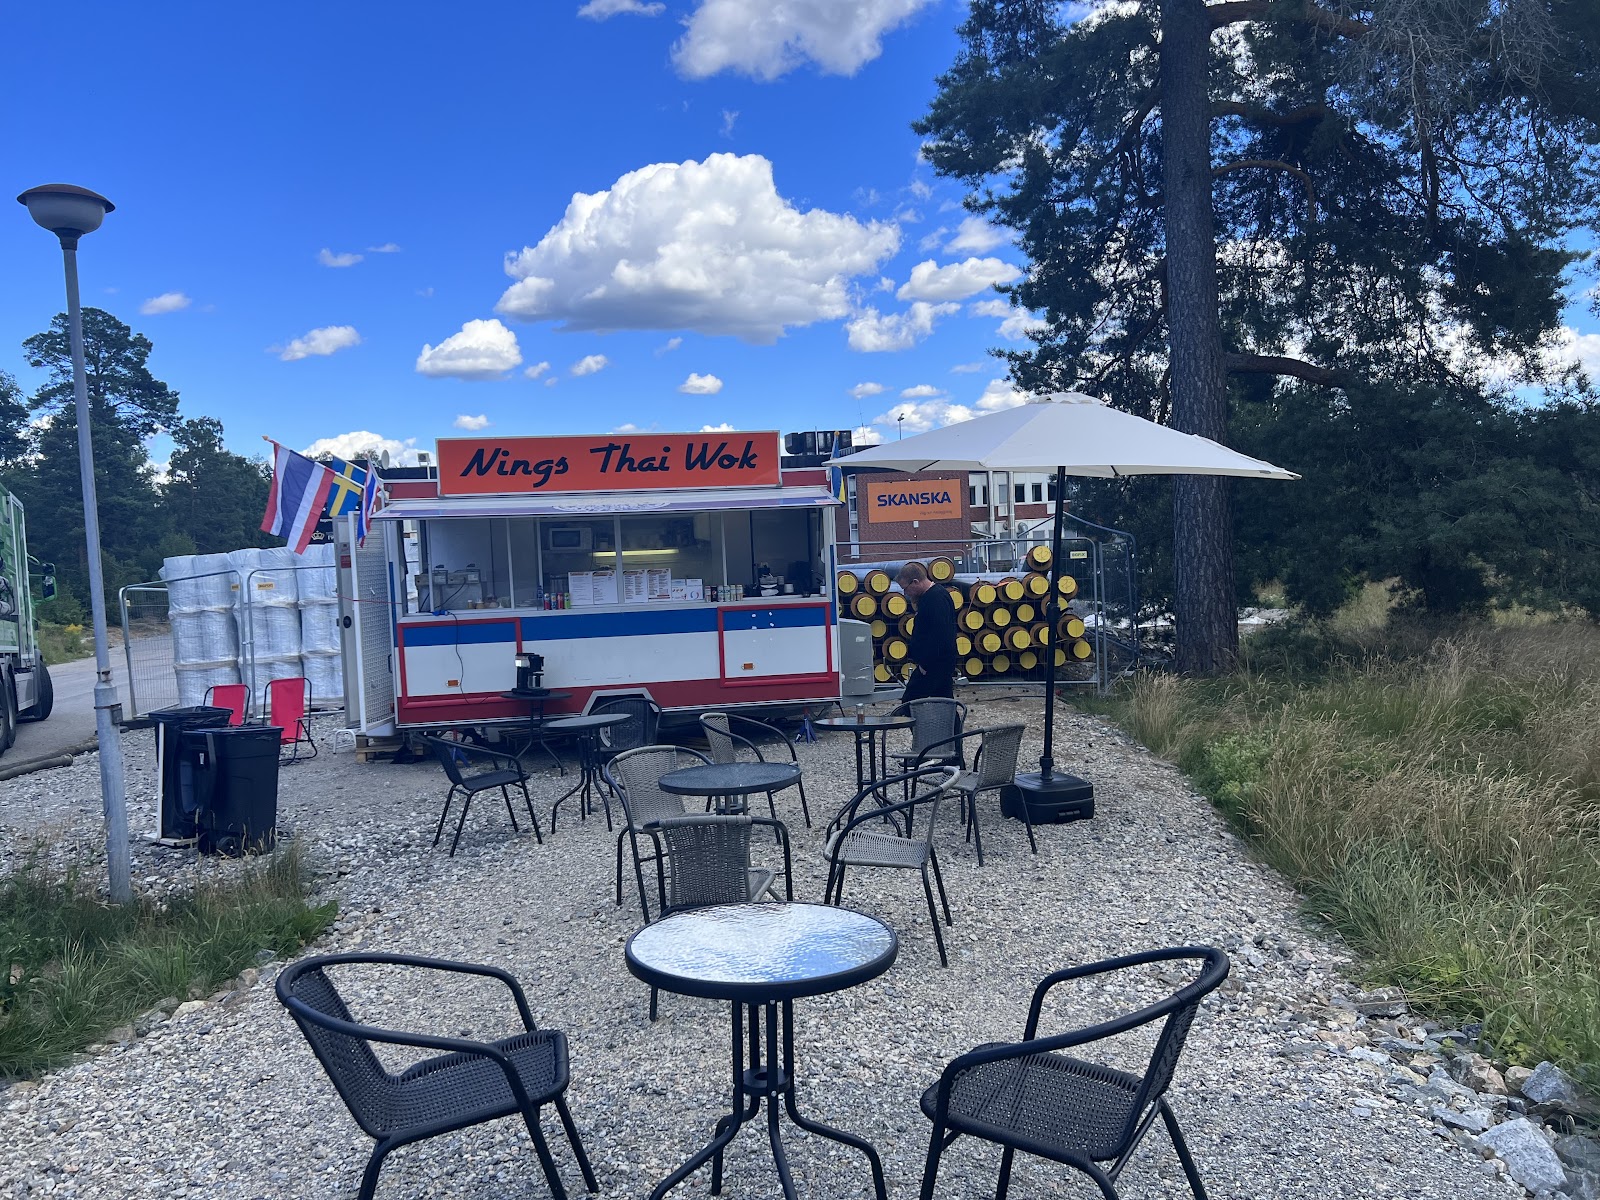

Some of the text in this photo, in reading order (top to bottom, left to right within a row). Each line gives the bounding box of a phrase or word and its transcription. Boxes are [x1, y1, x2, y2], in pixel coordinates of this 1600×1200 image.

[460, 440, 757, 488] Nings Thai Wok
[877, 491, 952, 507] SKANSKA
